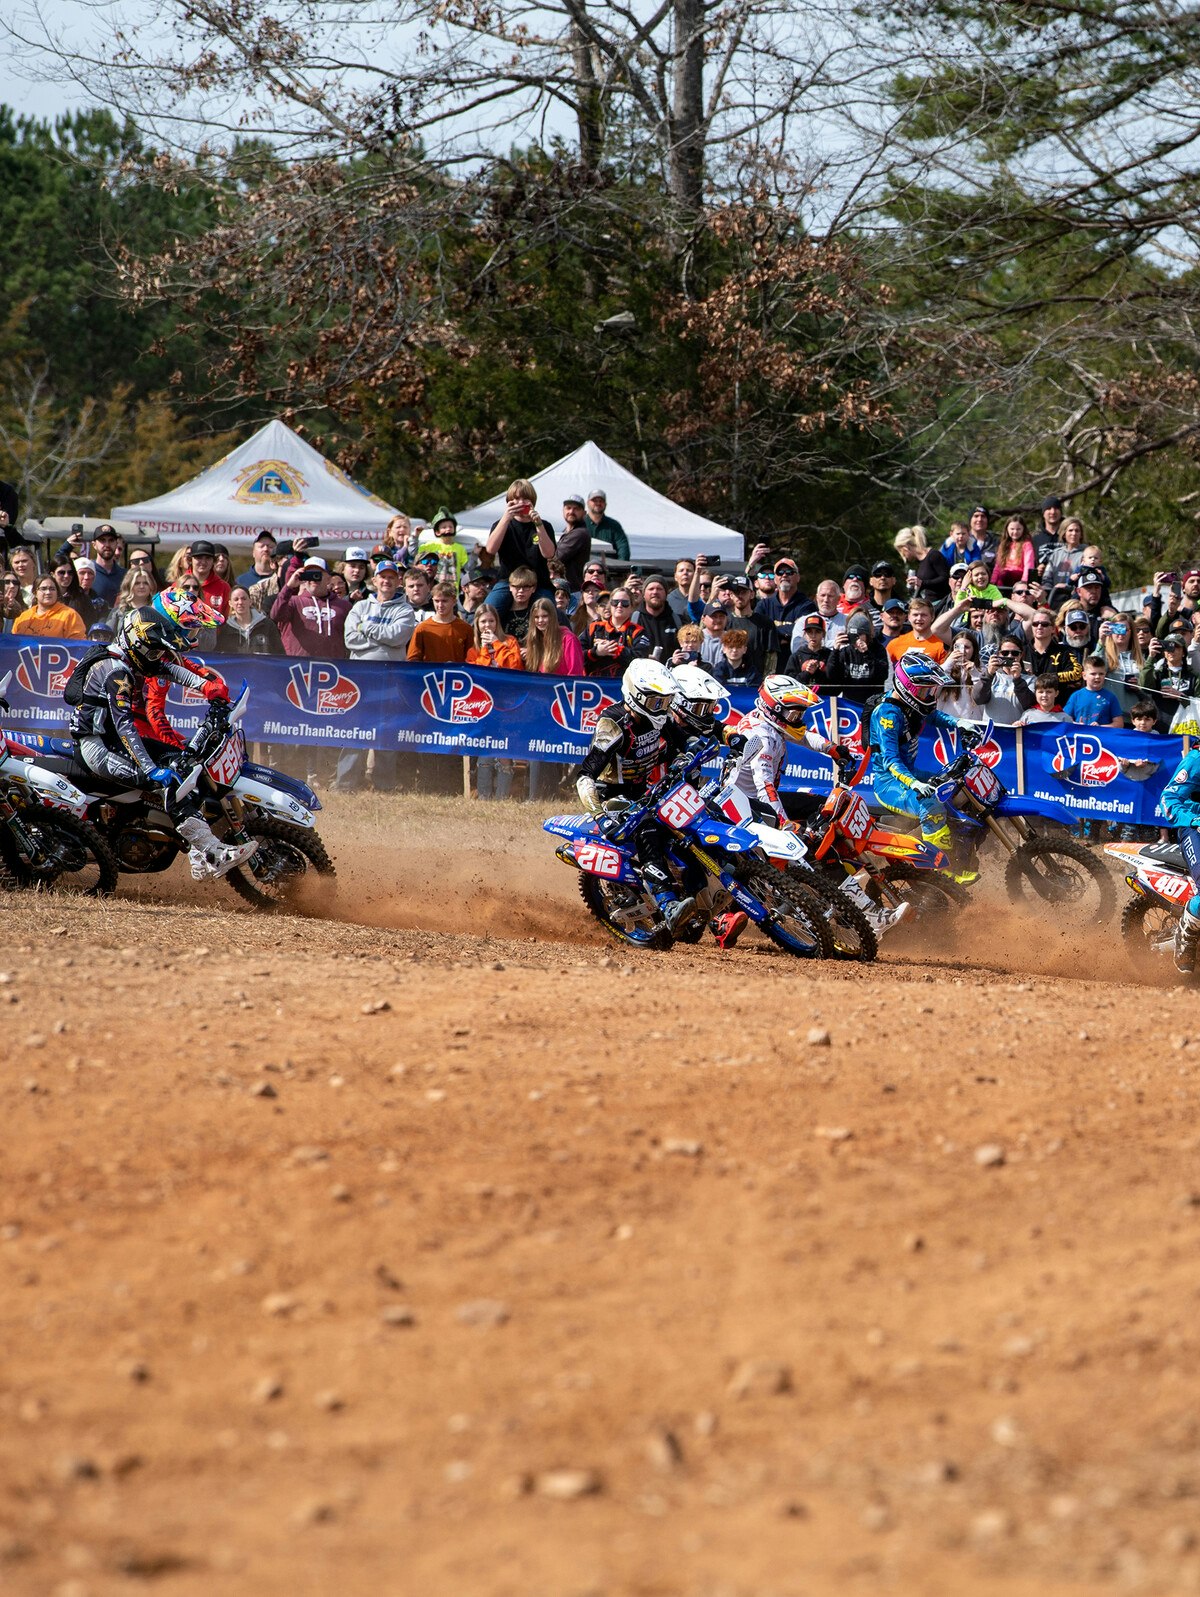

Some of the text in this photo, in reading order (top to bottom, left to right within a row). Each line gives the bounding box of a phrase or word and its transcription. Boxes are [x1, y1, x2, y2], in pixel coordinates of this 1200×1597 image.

[318, 528, 388, 541] ASSOCIATI
[18, 644, 71, 695] VP
[289, 661, 340, 714] VP
[319, 690, 358, 708] Racing
[423, 670, 473, 722] VP
[453, 700, 491, 715] Racing
[554, 681, 603, 732] VP
[263, 721, 376, 741] #MoreThanRaceFuel
[398, 730, 509, 750] #MoreThanRaceFuel
[528, 739, 589, 756] #MoreThan
[1083, 761, 1118, 779] Racing
[1083, 779, 1107, 787] FUELS
[660, 784, 705, 829] 212
[849, 801, 871, 839] 530
[577, 846, 620, 876] 212
[1184, 835, 1198, 867] MSR
[1153, 875, 1189, 899] 407
